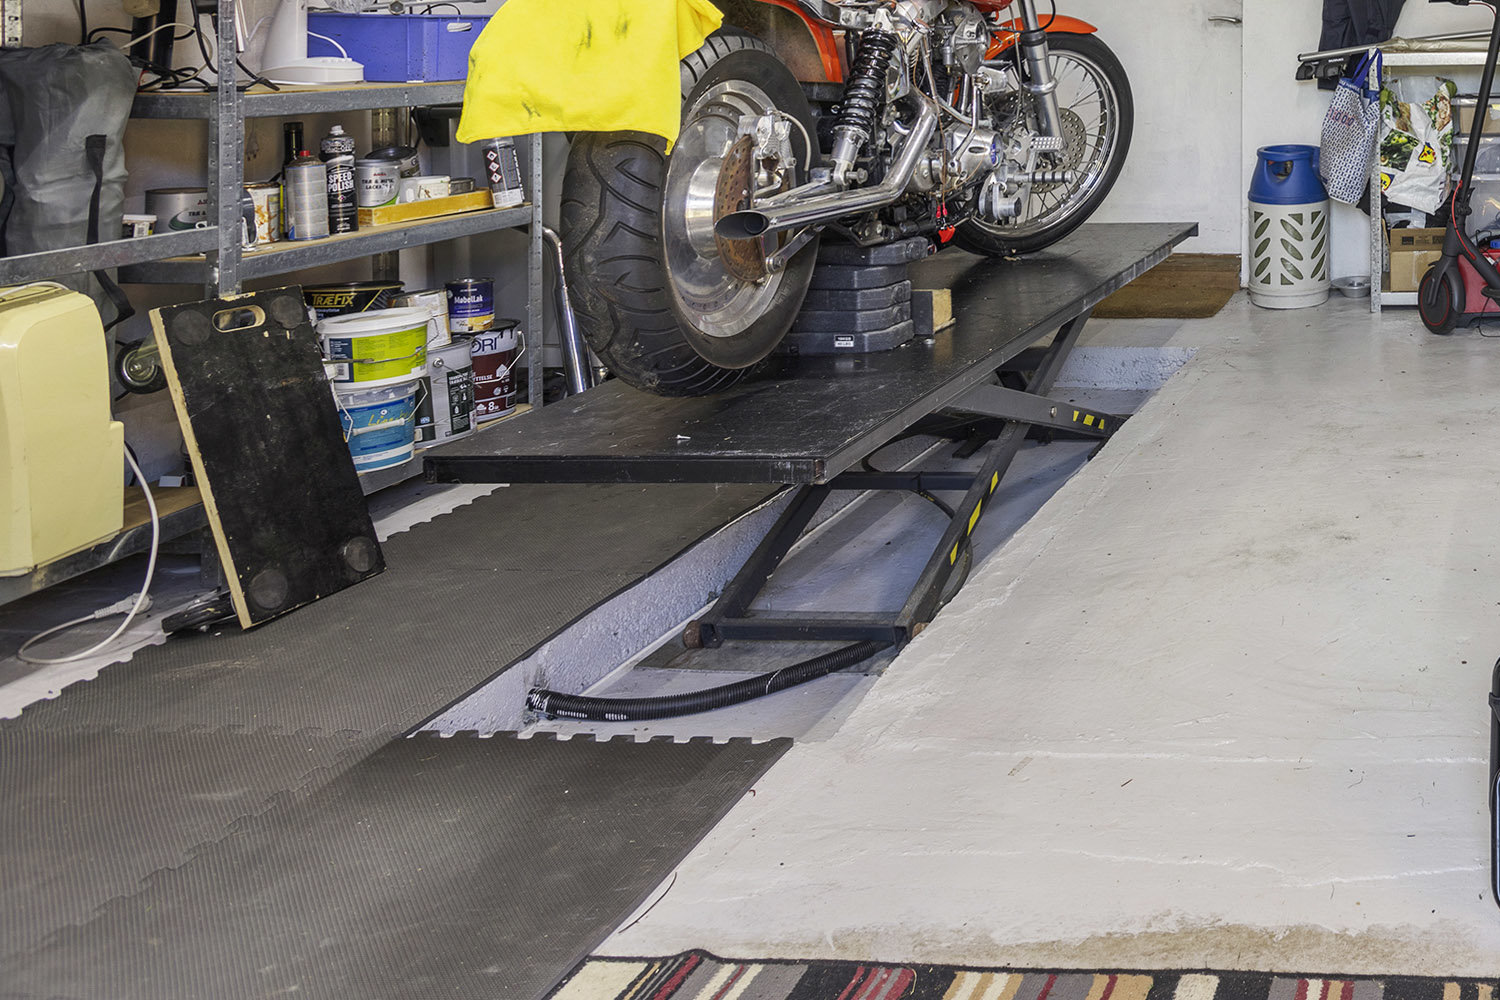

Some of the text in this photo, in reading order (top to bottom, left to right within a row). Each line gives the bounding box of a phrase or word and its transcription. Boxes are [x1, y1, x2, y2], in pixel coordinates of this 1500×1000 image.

[328, 172, 353, 184] SPEED
[328, 182, 354, 194] POLISH
[312, 293, 357, 307] TRÆFIX
